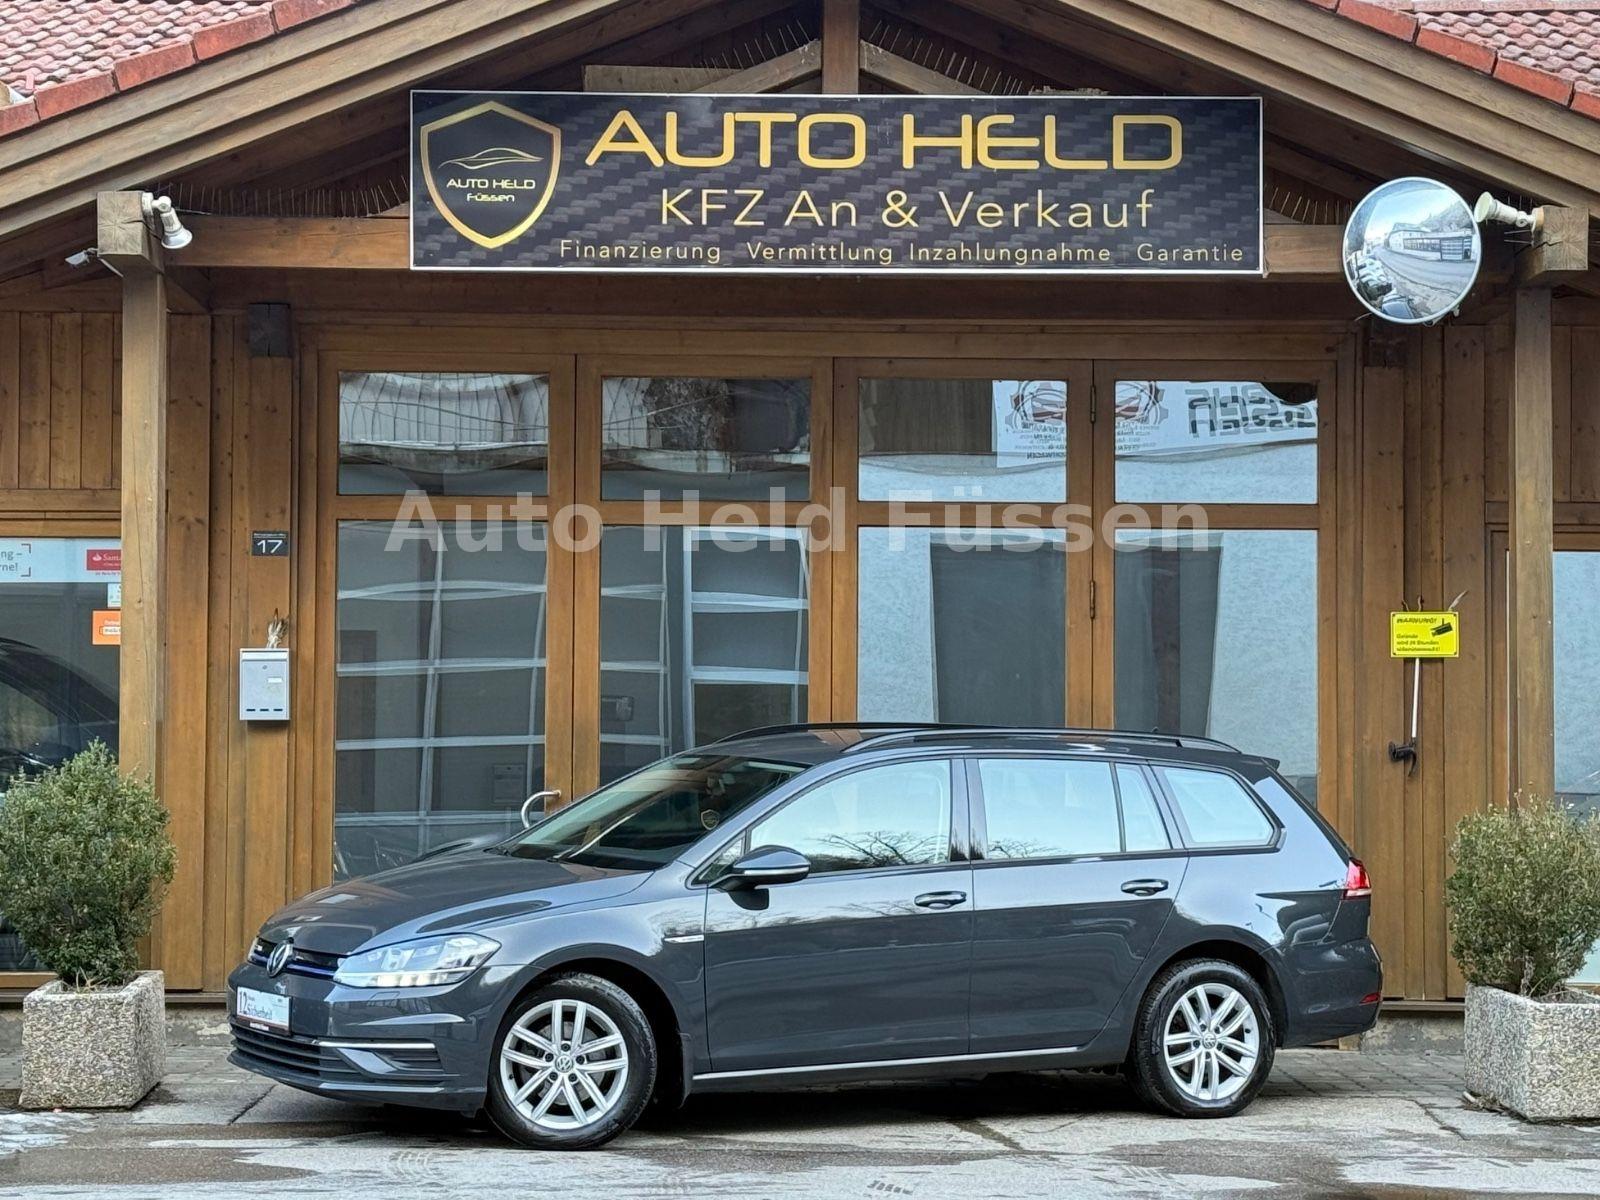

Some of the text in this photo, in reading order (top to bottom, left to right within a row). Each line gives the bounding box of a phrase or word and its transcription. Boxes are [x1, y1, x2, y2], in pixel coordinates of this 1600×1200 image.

[585, 109, 1183, 171] AUTO HELD
[446, 178, 536, 189] AUTO HELD
[661, 187, 1155, 228] KFZ An & Verkauf
[559, 239, 1244, 266] Finanzierung Vermittlung Inzahlungnahme Garantie
[256, 539, 283, 554] 17
